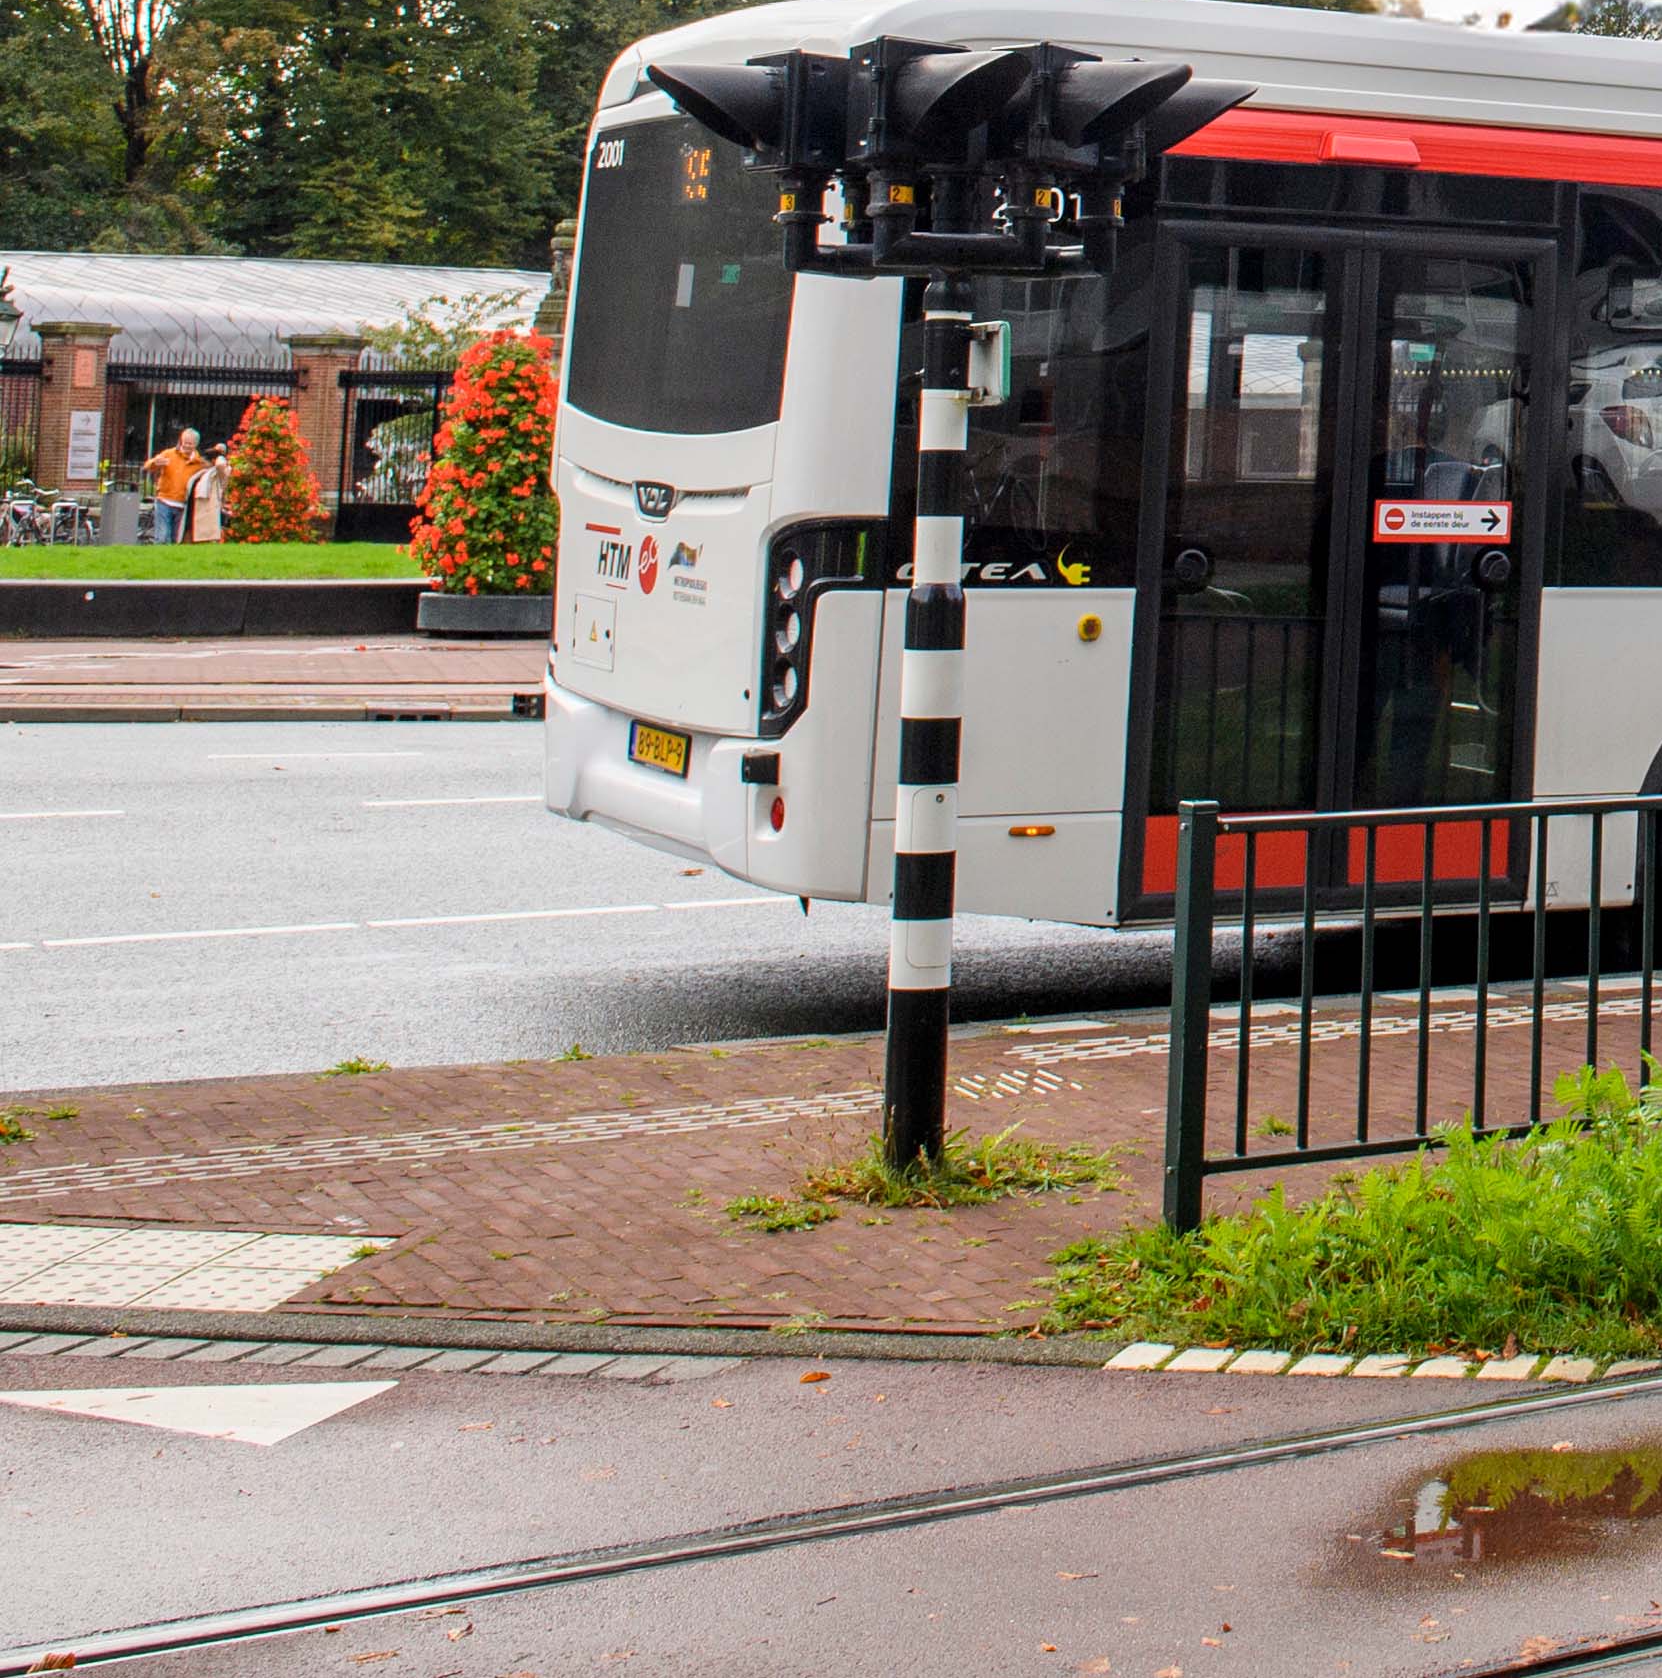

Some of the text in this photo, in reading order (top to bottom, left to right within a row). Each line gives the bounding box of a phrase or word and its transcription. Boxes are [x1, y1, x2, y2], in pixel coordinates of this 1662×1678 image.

[597, 139, 625, 169] 2001
[638, 485, 670, 511] VDL
[1411, 510, 1464, 521] Instappen bij
[1411, 520, 1421, 528] de
[1451, 521, 1470, 529] deur
[597, 539, 632, 580] HTM
[896, 562, 1048, 580] CTEA
